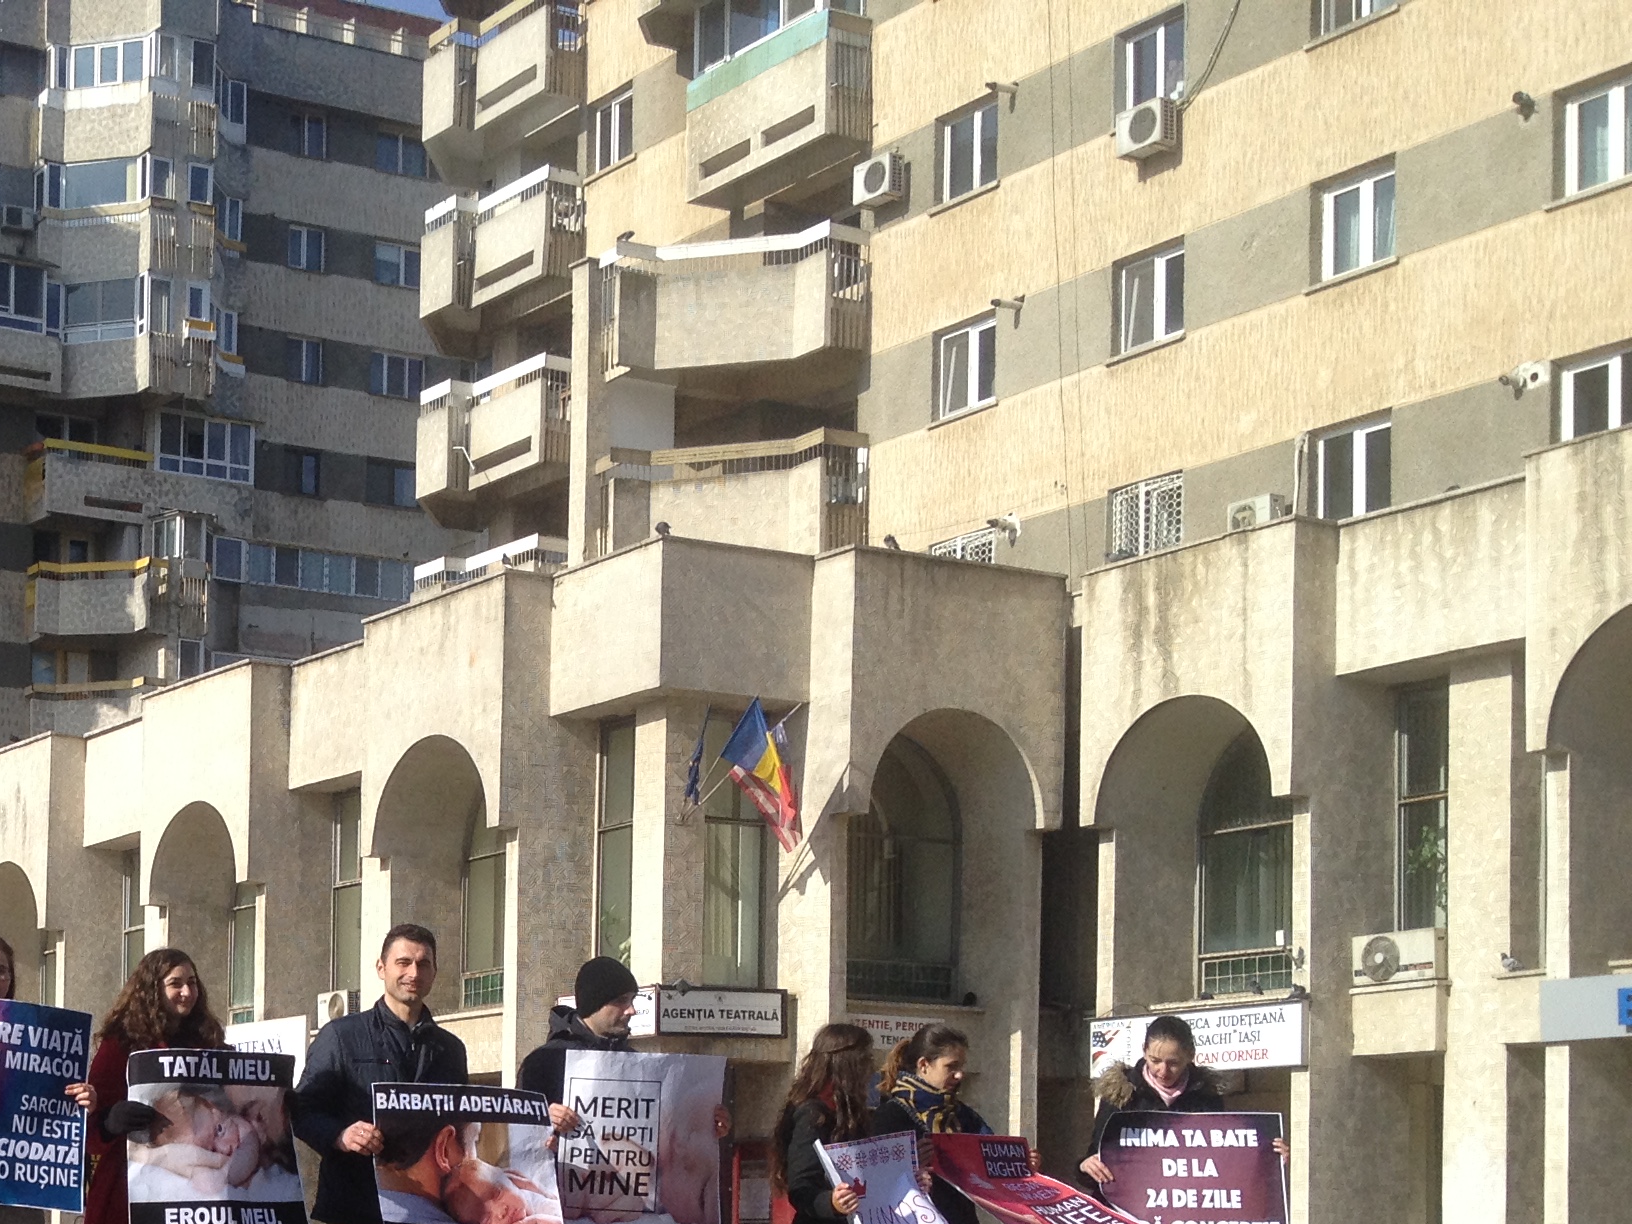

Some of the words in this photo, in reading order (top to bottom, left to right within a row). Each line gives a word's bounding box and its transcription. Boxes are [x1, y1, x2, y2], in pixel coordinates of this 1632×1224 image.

[1222, 1048, 1269, 1062] CORNER
[5, 1052, 82, 1080] MIRACOL
[158, 1052, 223, 1078] TATĂL
[228, 1058, 276, 1081] MEU.
[20, 1094, 81, 1118] SARCINA
[574, 1096, 656, 1120] MERIT
[12, 1114, 38, 1135] NU
[42, 1120, 80, 1140] ESTE
[1120, 1126, 1180, 1147] INIMA
[1182, 1129, 1206, 1148] TA
[1209, 1129, 1258, 1148] BATE
[570, 1147, 652, 1168] PENTRU
[980, 1142, 1026, 1158] HUMAN
[986, 1161, 1031, 1177] RIGHTS
[1162, 1158, 1186, 1177] DE
[1192, 1158, 1218, 1178] LA
[569, 1168, 651, 1196] MINE
[1030, 1196, 1088, 1216] HUMAN
[1146, 1188, 1168, 1208] 24
[1172, 1190, 1198, 1208] DE
[1202, 1190, 1242, 1208] ZILE
